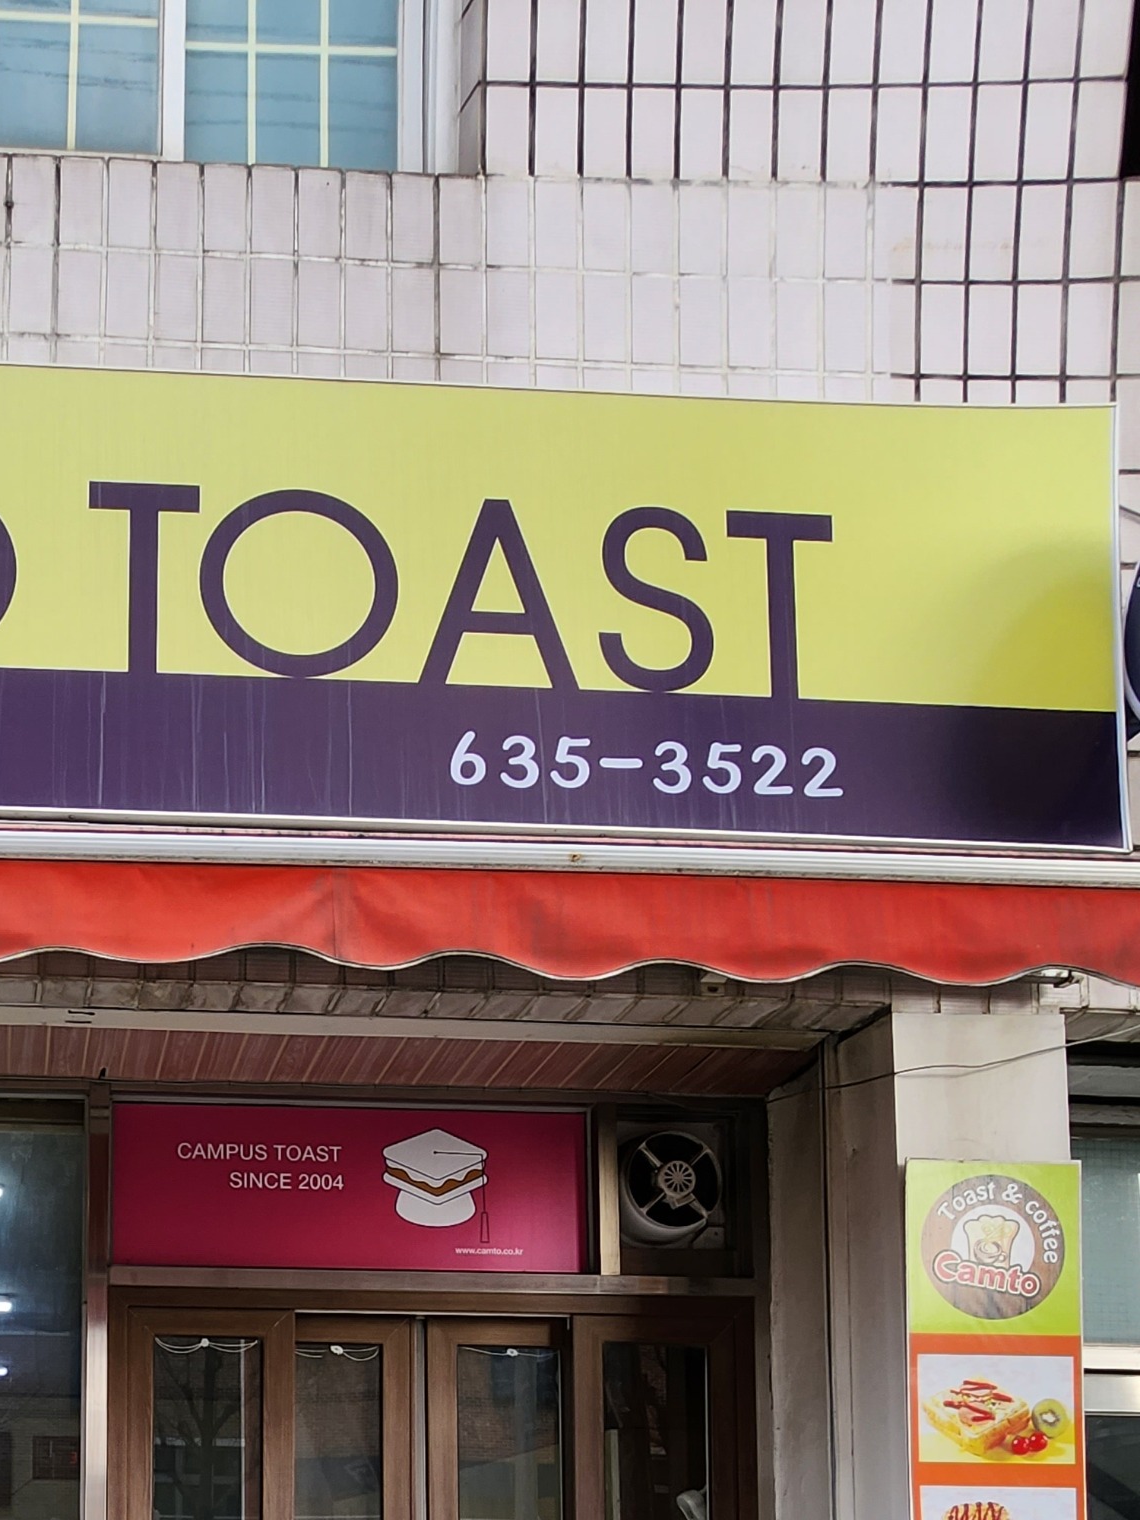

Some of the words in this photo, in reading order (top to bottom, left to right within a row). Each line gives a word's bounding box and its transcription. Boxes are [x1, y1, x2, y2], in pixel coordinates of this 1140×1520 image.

[88, 480, 833, 699] TOAST
[449, 731, 844, 798] 635-3522
[177, 1142, 268, 1161] CAMPUS
[273, 1145, 342, 1162] TOAST
[229, 1172, 292, 1190] SINCE
[298, 1174, 344, 1190] 2004
[937, 1181, 996, 1221] Toast
[1001, 1183, 1023, 1205] &
[1025, 1200, 1060, 1264] coffee
[455, 1247, 524, 1256] www.camto.co.kr
[934, 1250, 1041, 1298] Camto
